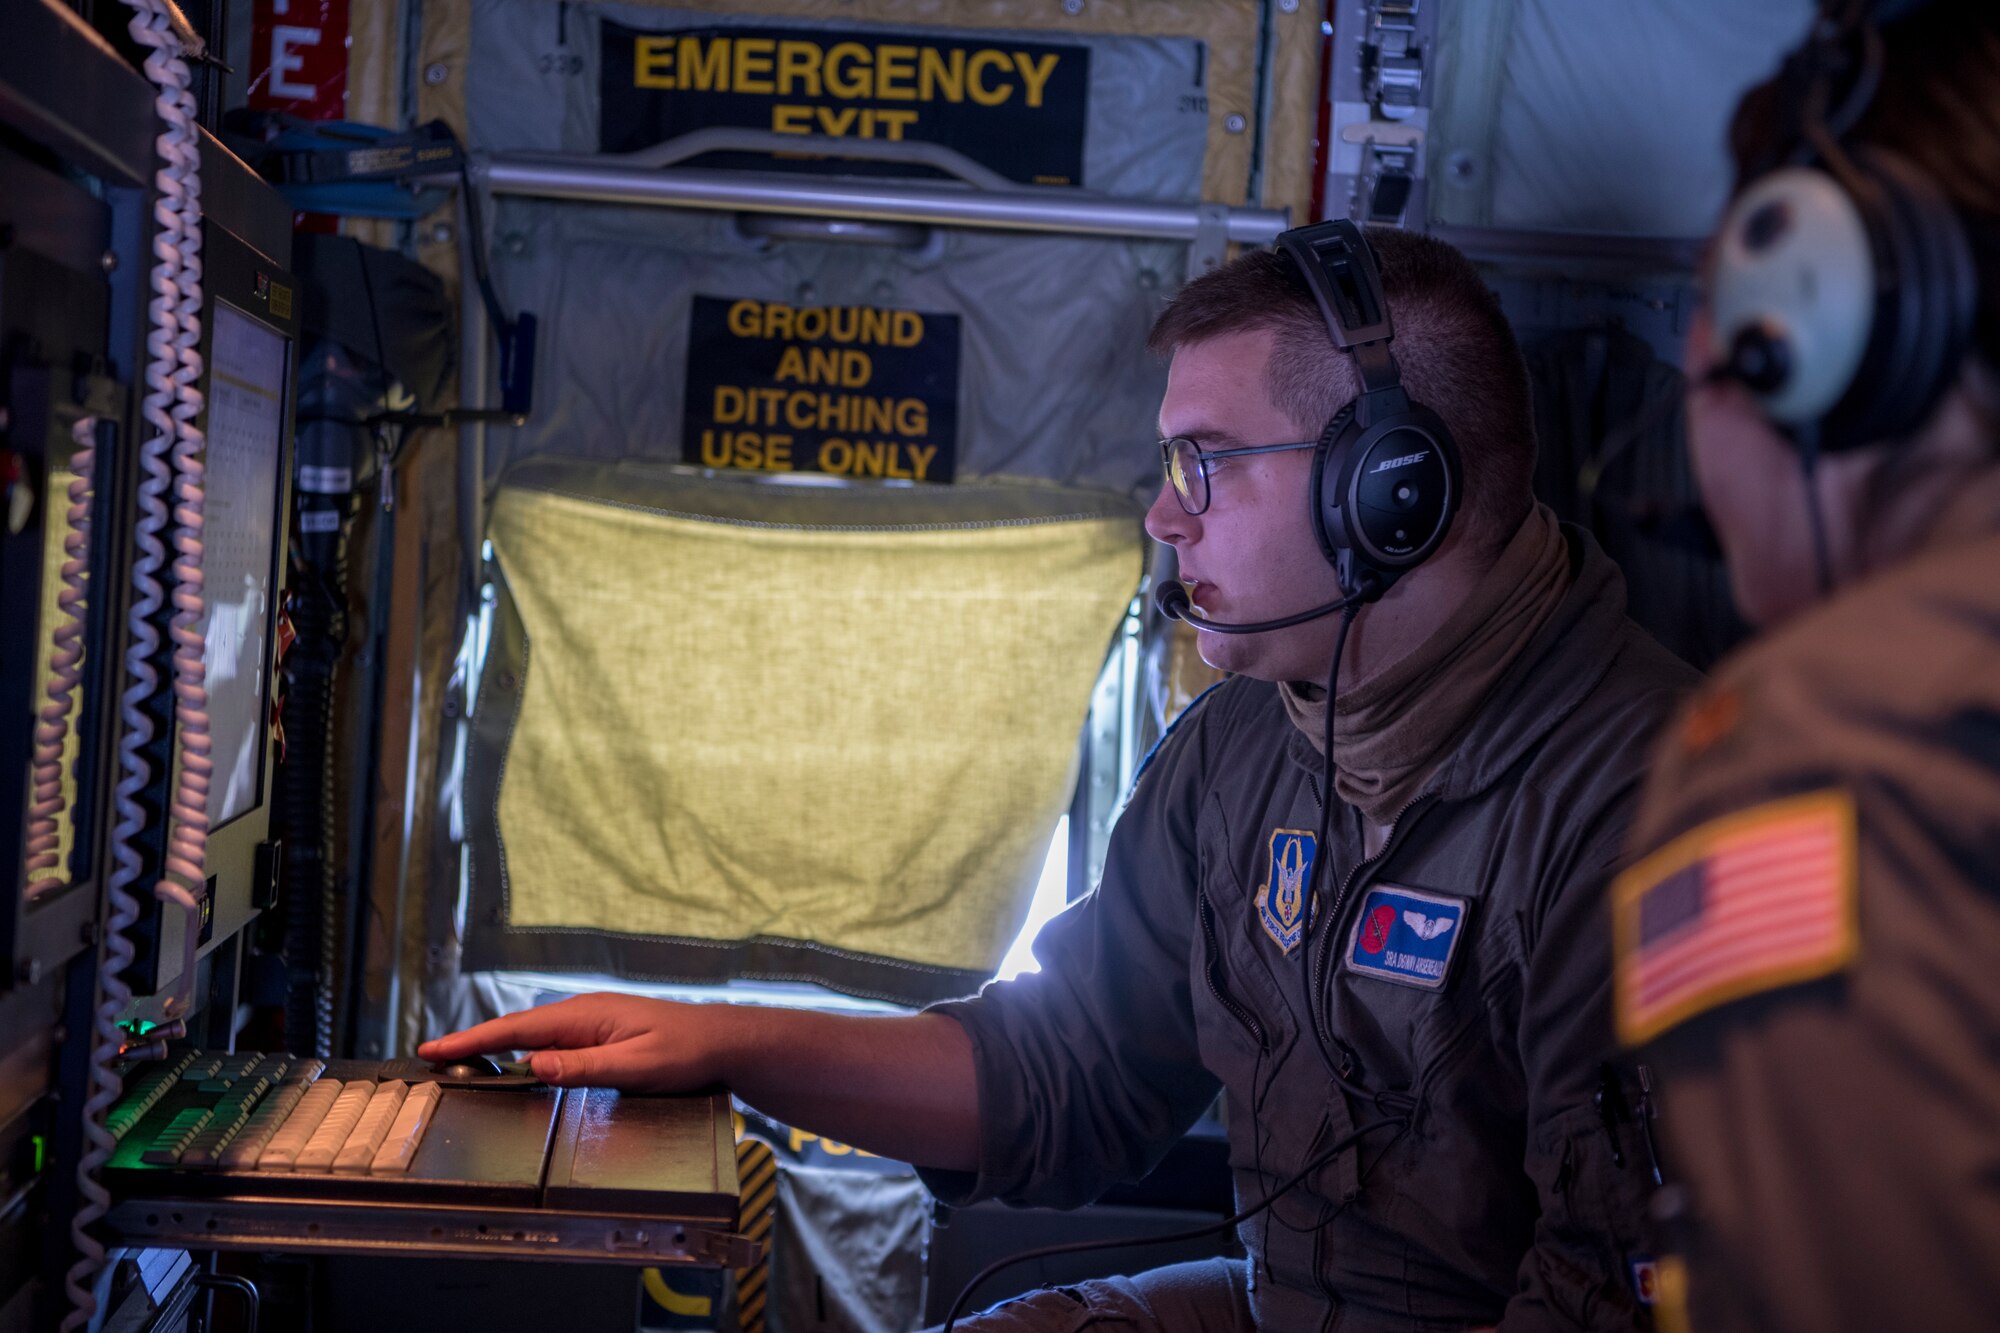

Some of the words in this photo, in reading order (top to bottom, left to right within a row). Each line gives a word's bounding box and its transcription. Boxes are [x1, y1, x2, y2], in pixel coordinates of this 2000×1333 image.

[269, 0, 322, 101] E
[634, 35, 1060, 107] EMERGENCY
[727, 299, 924, 347] GROUND
[775, 346, 872, 388] AND
[713, 385, 929, 436] DITCHING
[702, 430, 794, 472] USE
[818, 437, 938, 481] ONLY
[1369, 451, 1430, 474] BOSE
